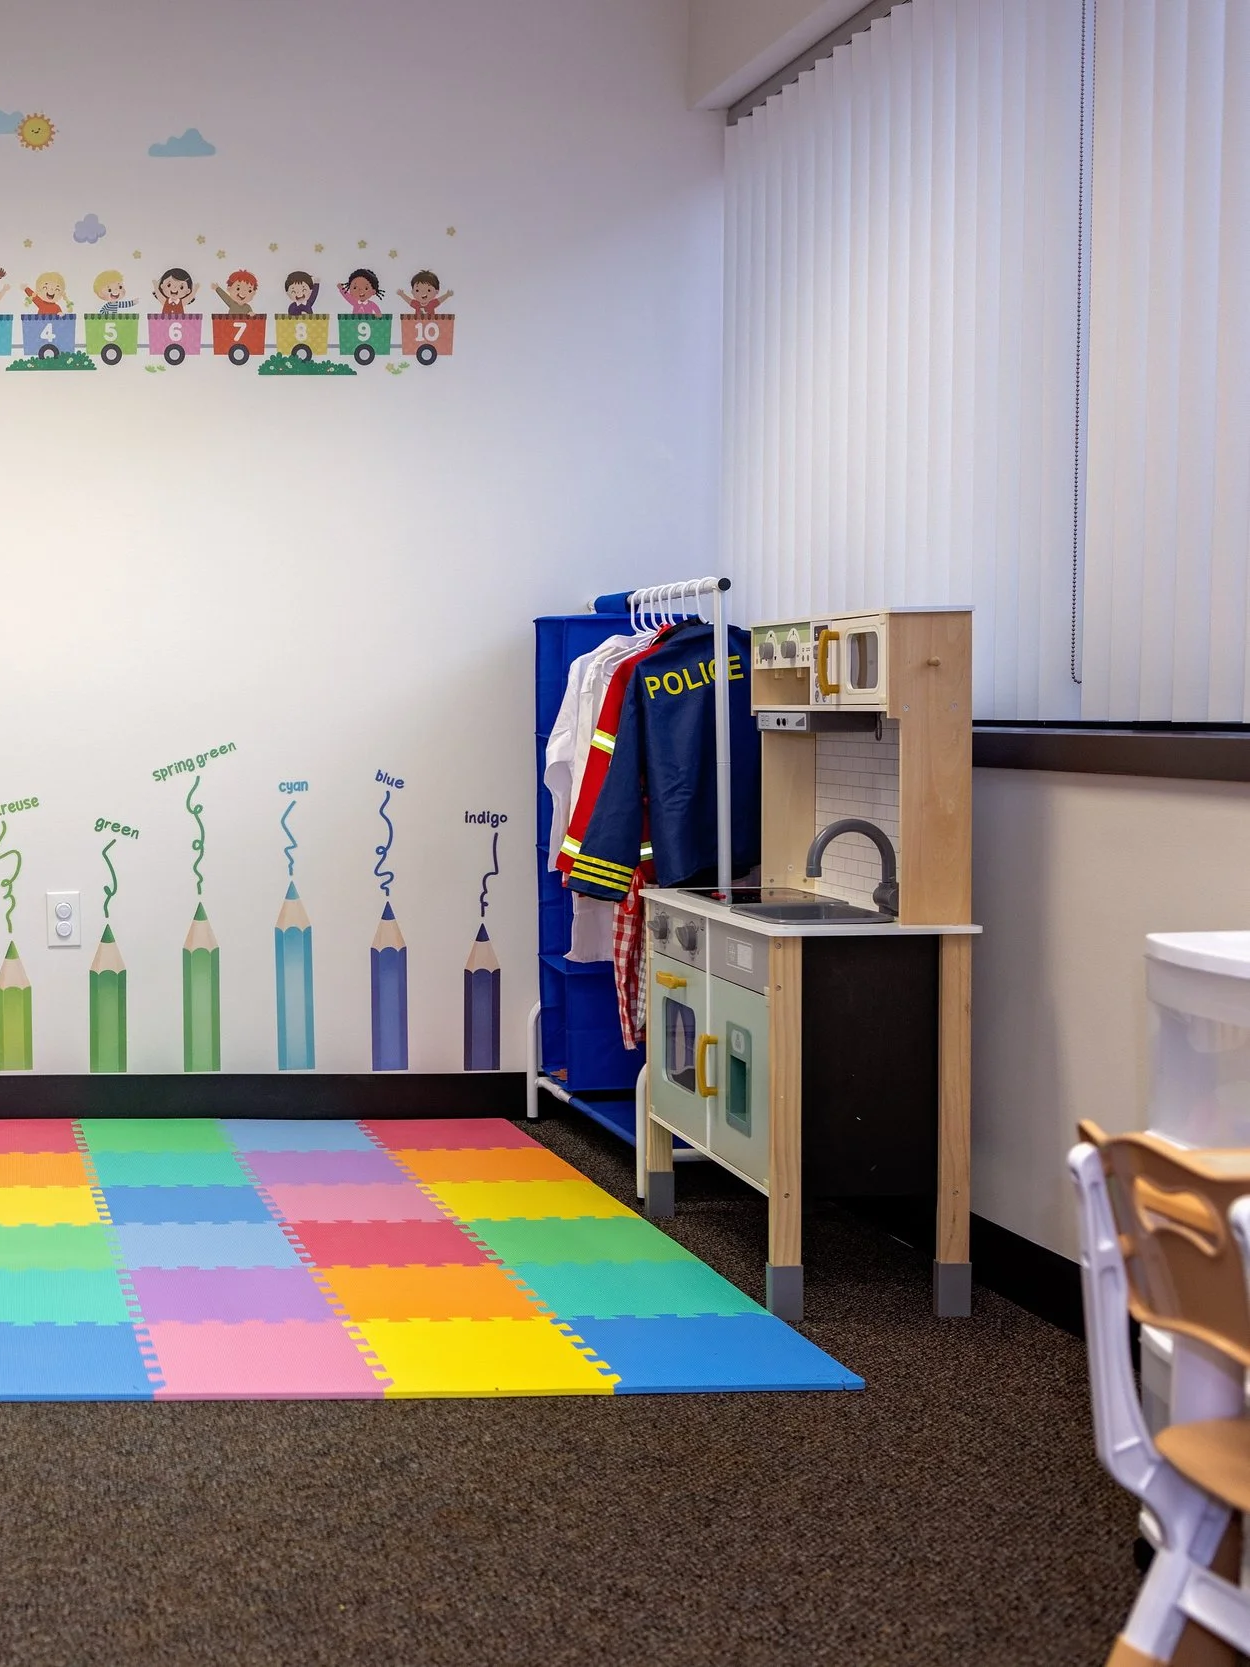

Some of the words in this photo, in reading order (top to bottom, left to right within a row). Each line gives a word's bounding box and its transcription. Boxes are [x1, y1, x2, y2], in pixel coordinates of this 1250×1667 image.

[39, 322, 56, 343] 4
[103, 322, 119, 343] 5
[167, 322, 183, 343] 6
[232, 321, 248, 343] 7
[294, 322, 309, 343] 8
[357, 322, 373, 343] 9
[413, 322, 441, 343] 10
[152, 757, 195, 782] spring
[196, 741, 236, 767] green
[278, 780, 308, 794] cyan
[375, 769, 404, 789] blue
[94, 817, 139, 839] green
[464, 811, 508, 828] indigo
